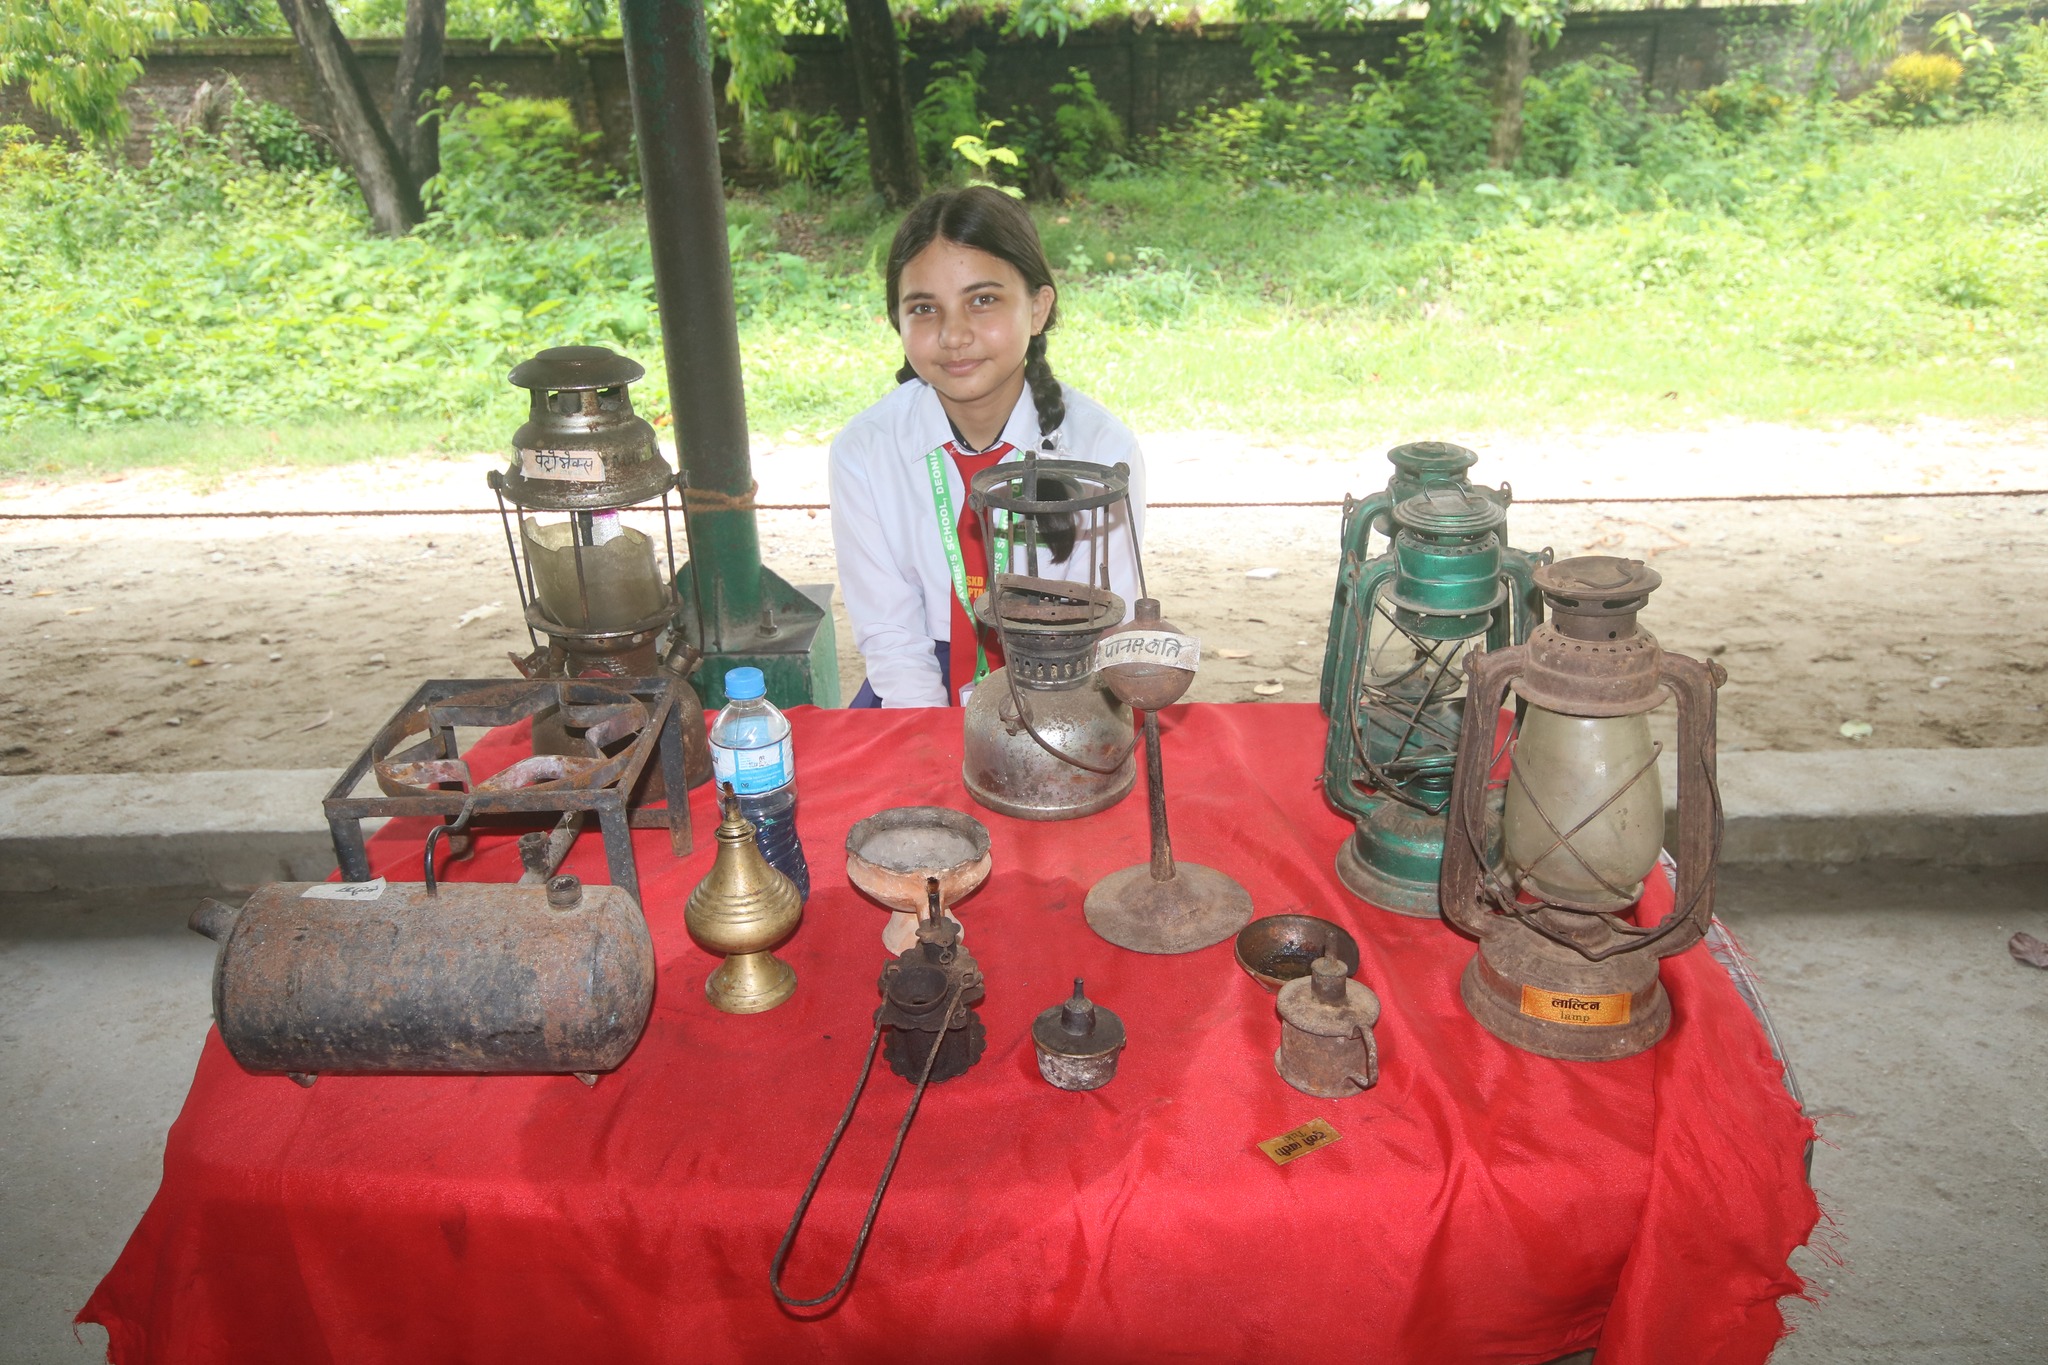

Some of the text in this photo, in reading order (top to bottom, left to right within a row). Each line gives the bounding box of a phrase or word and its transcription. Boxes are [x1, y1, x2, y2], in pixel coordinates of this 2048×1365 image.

[938, 497, 956, 551] SCHOOL,
[949, 554, 968, 608] XAVIER'S
[1551, 997, 1601, 1011] लाल्टिन
[1560, 1010, 1590, 1023] lamp
